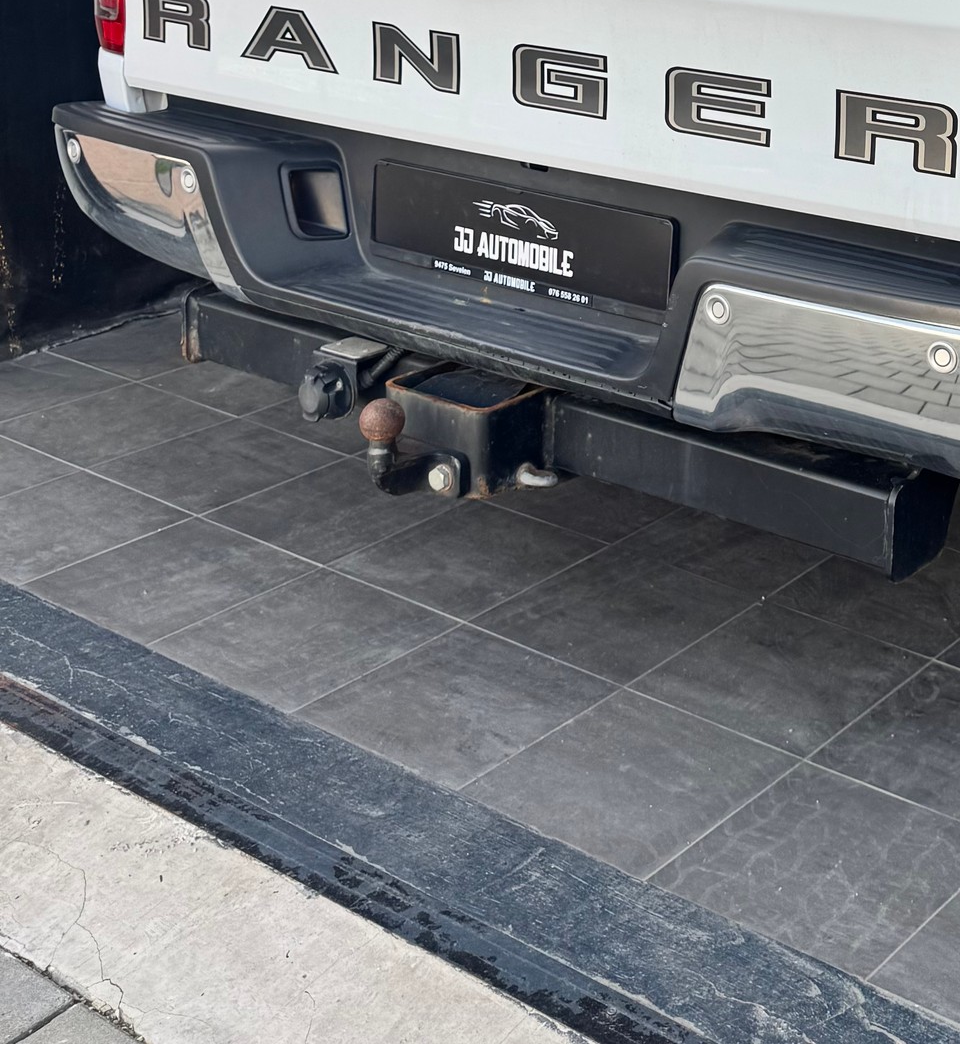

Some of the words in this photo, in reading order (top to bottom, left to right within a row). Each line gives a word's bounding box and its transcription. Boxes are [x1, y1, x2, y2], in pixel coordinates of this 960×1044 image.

[453, 225, 474, 255] JJ
[476, 231, 575, 278] AUTOMOBILE
[493, 273, 536, 293] AUTOMOBILE
[548, 287, 560, 298] 076
